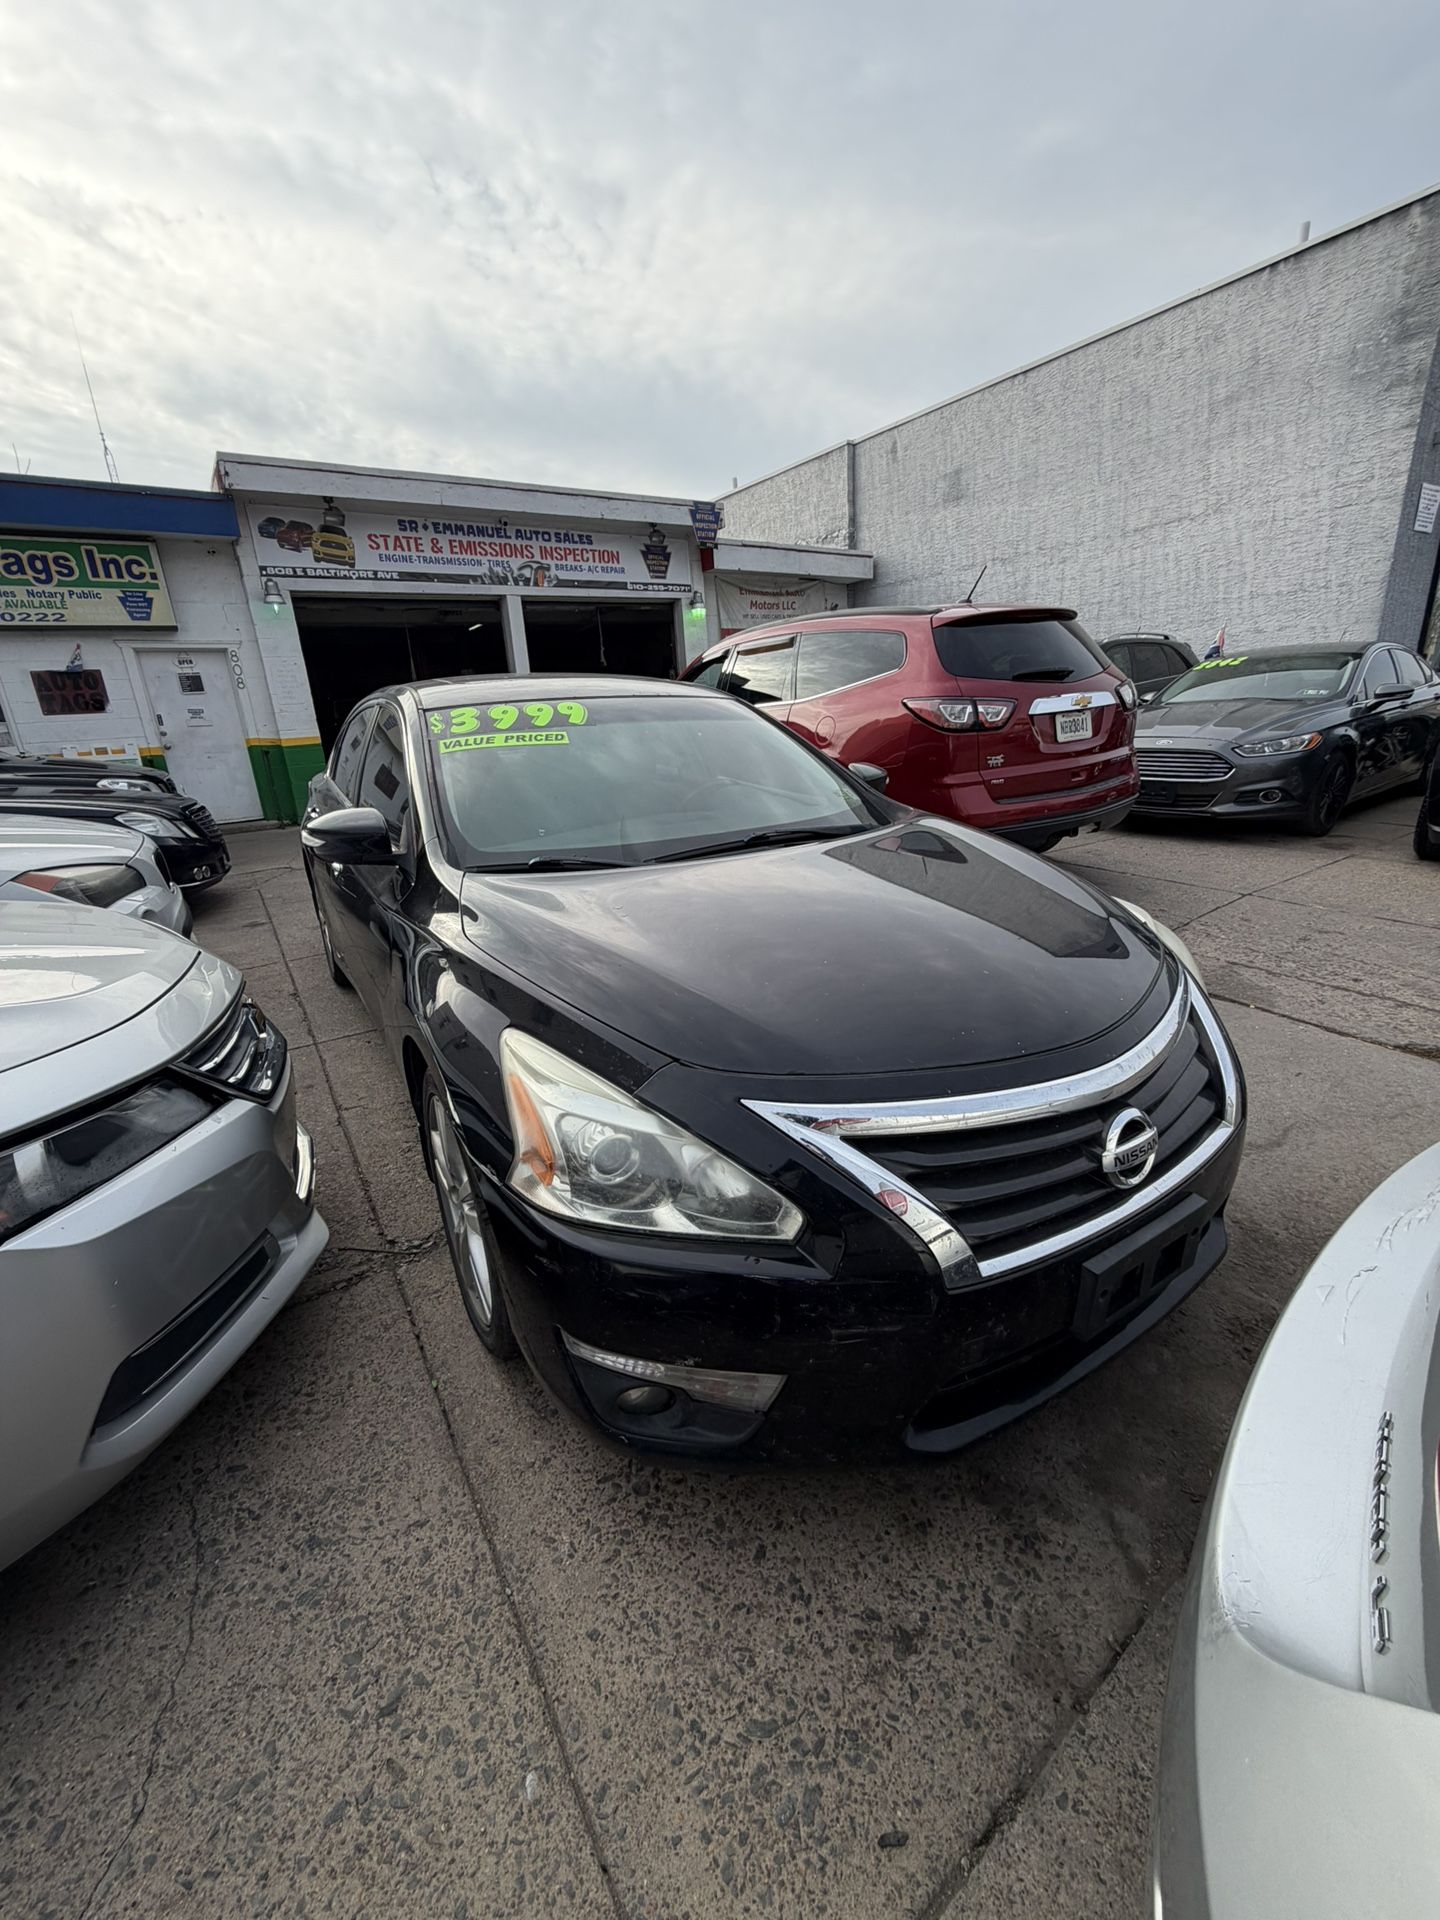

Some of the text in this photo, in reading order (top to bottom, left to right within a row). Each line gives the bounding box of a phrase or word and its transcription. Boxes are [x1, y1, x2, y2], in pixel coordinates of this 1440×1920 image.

[431, 521, 512, 540] EMMANUEL
[515, 528, 551, 543] AUTO
[555, 532, 594, 546] SALES
[367, 533, 620, 565] STATE & EMISSIONS INSPECTION
[83, 546, 160, 583] Inc.
[488, 559, 512, 569] TIRES
[601, 565, 626, 575] REPAIR
[306, 568, 375, 579] BALTIMORE
[377, 571, 400, 580] AVE
[27, 589, 65, 601] Notary
[68, 589, 102, 600] Public
[5, 600, 69, 610] AVAILABLE
[749, 600, 796, 610] Motors LLC
[36, 671, 99, 692] AUTO
[40, 692, 105, 714] TAGS
[443, 732, 565, 750] VALUE PRICED
[1113, 1137, 1159, 1168] NISSAN
